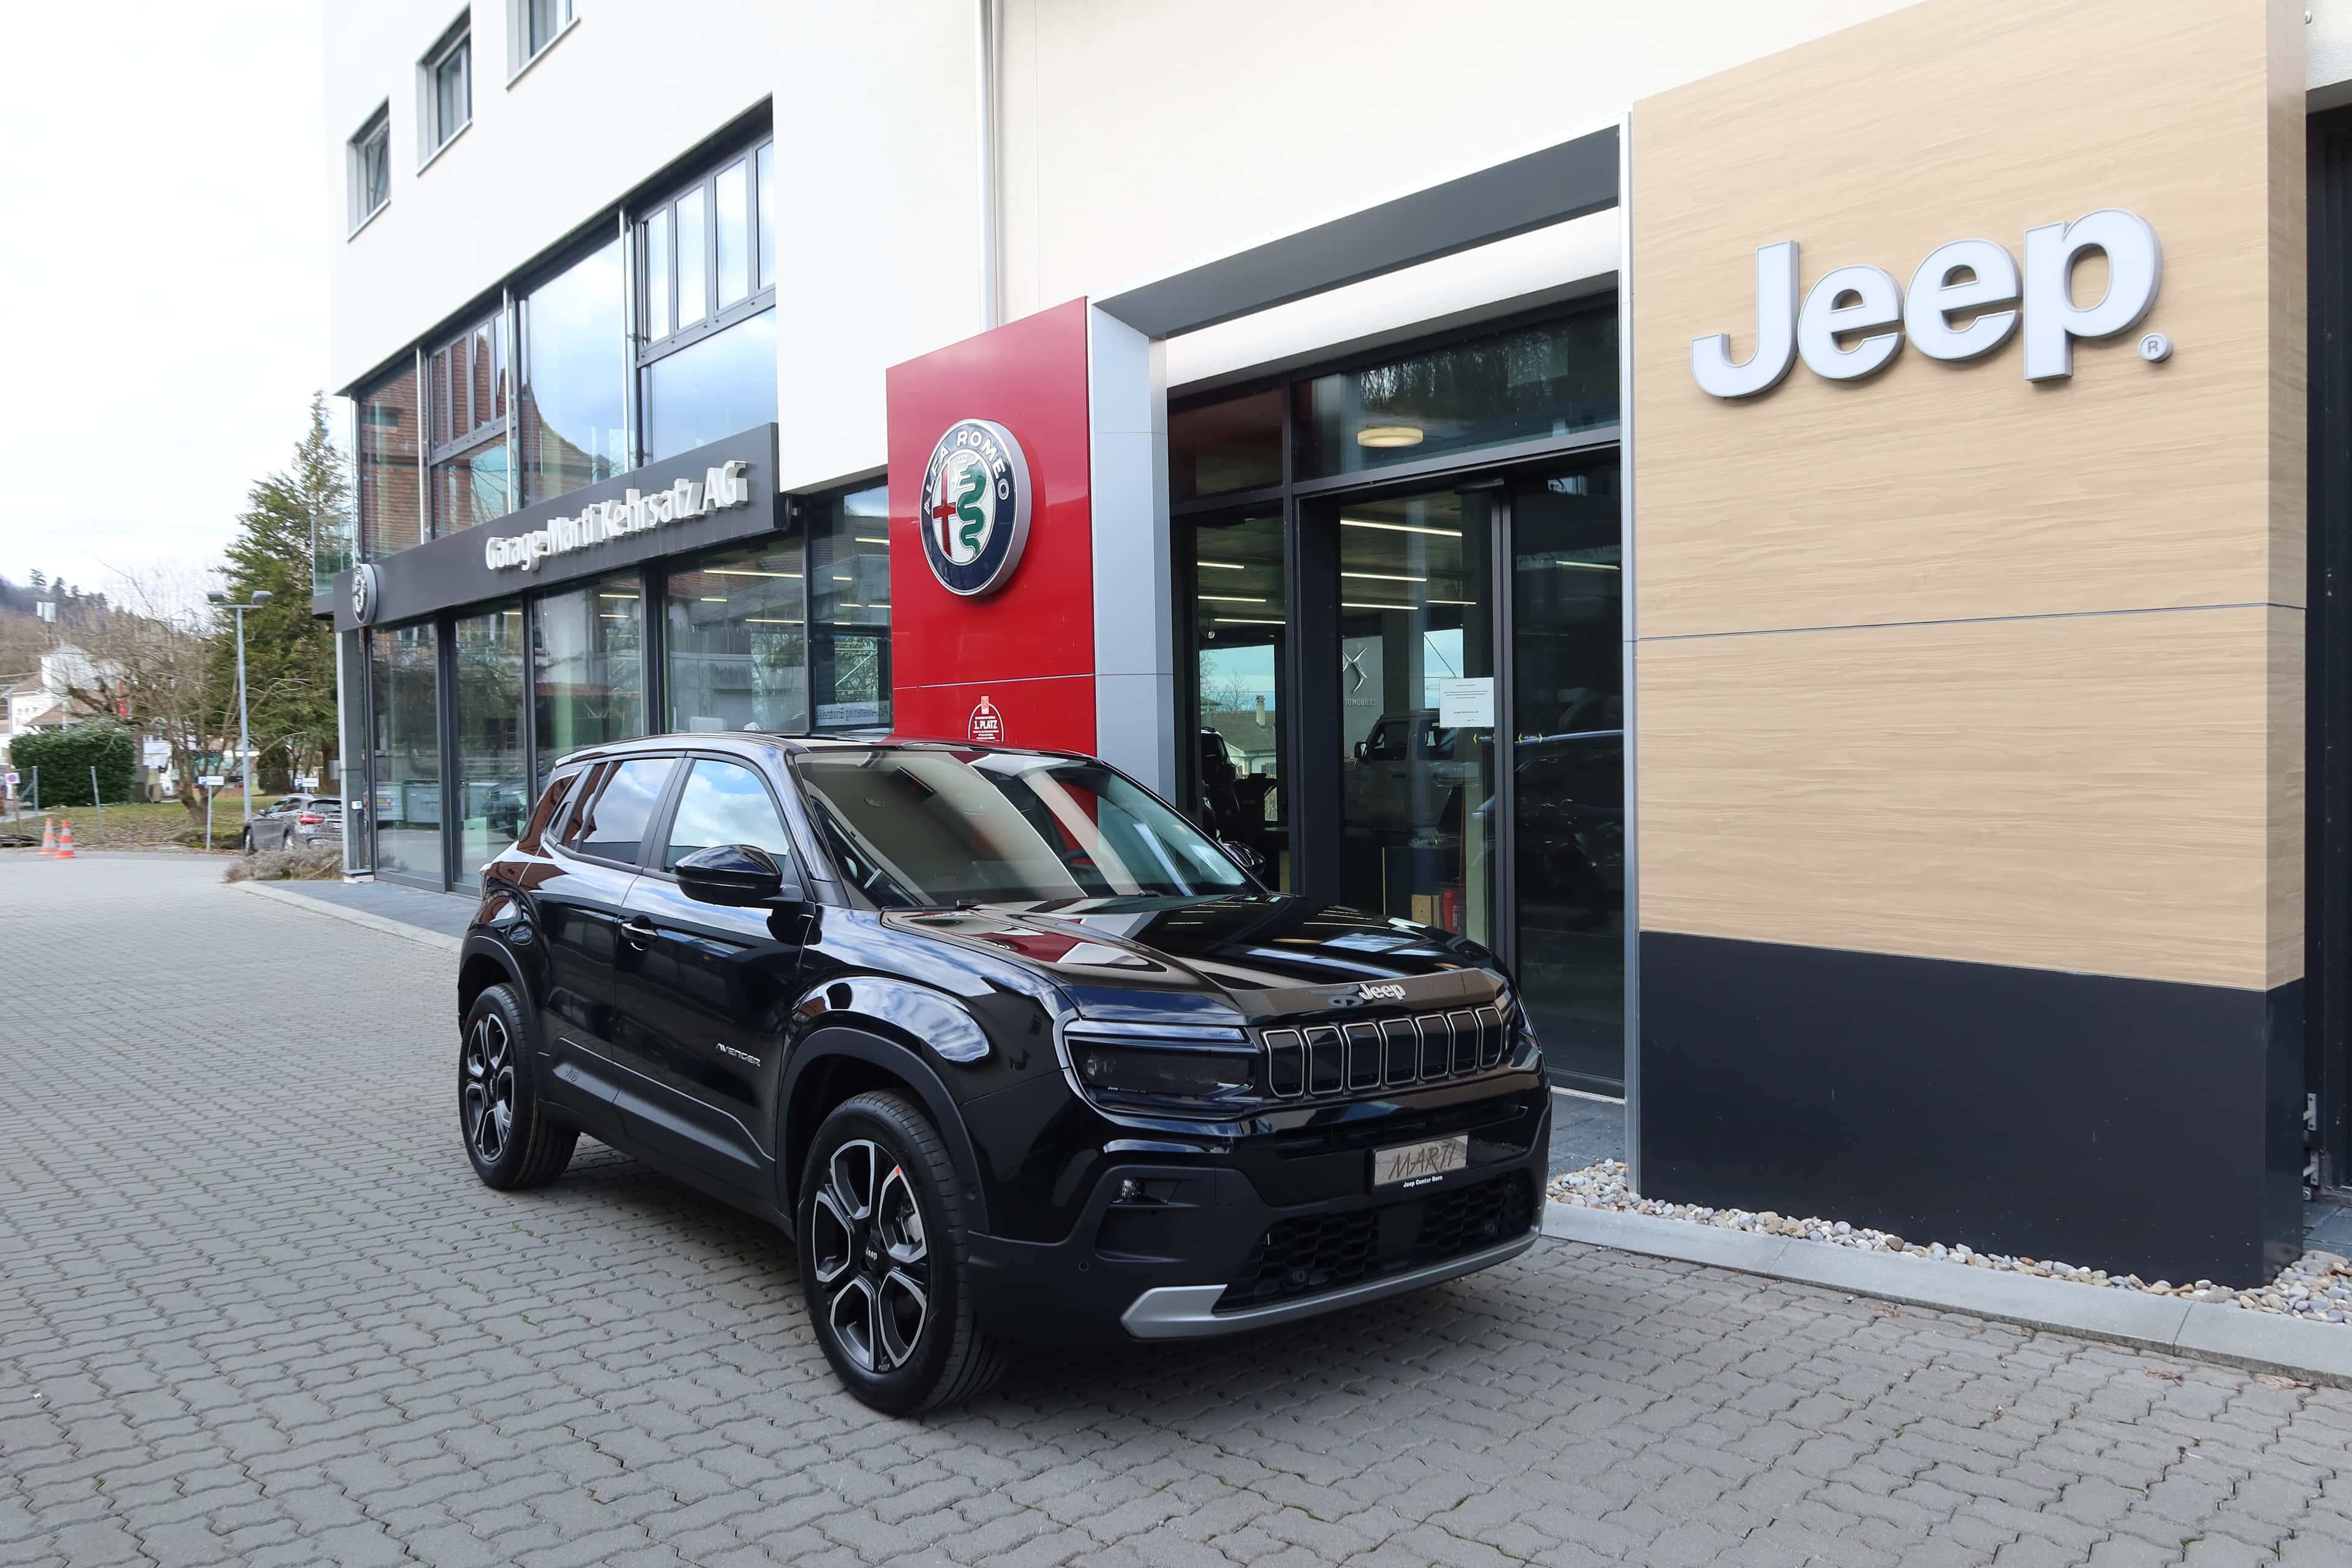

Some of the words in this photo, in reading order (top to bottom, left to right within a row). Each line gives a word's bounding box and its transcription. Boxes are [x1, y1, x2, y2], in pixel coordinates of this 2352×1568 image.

[1691, 208, 2162, 398] Jeep
[924, 445, 950, 515] ALFA
[956, 430, 1009, 500] ROMEO
[486, 530, 542, 571] Garage
[547, 504, 602, 557] Marti
[601, 478, 704, 539] Kehrsatz
[703, 460, 748, 513] AG
[974, 720, 979, 729] 1.
[980, 720, 998, 729] PLATZ
[1359, 984, 1406, 1000] Jeep
[1388, 1142, 1456, 1180] MARTI
[865, 1246, 878, 1261] Jeep
